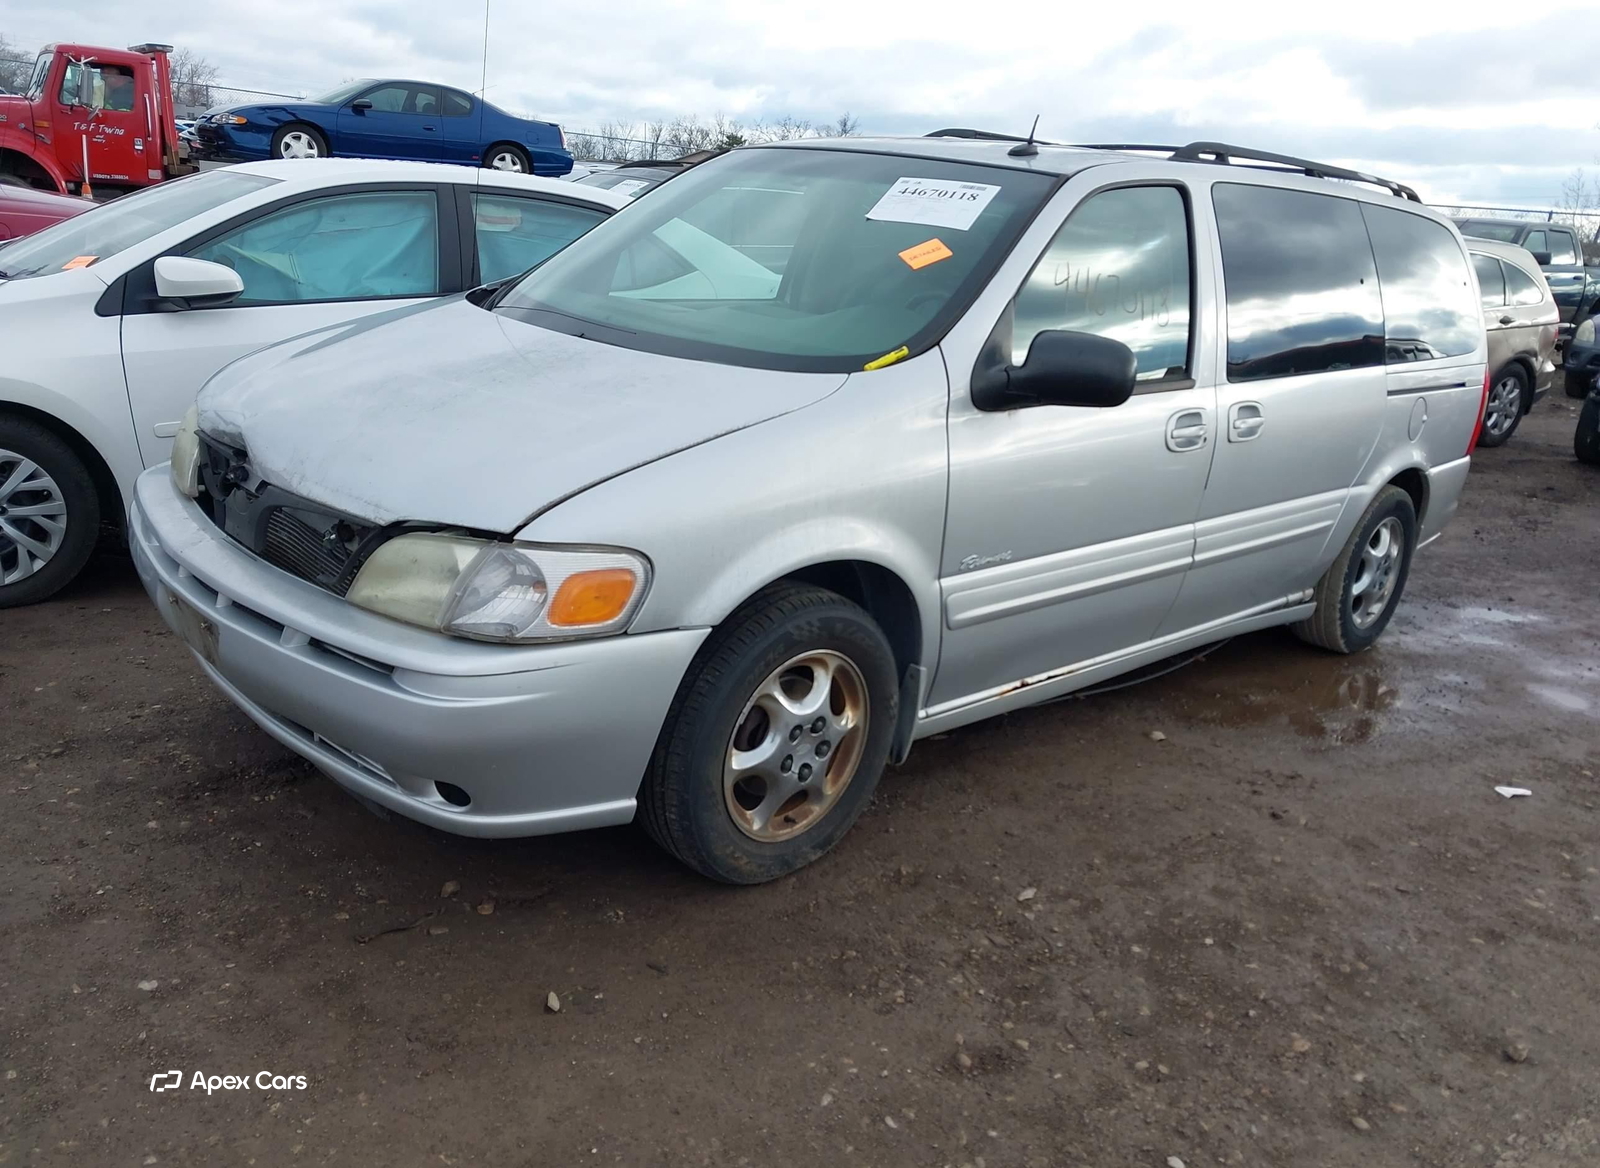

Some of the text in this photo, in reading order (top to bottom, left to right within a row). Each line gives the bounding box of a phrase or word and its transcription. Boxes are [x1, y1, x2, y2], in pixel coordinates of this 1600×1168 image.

[73, 121, 80, 130] T
[80, 123, 88, 131] &
[88, 122, 97, 132] F
[897, 186, 980, 202] 44670118
